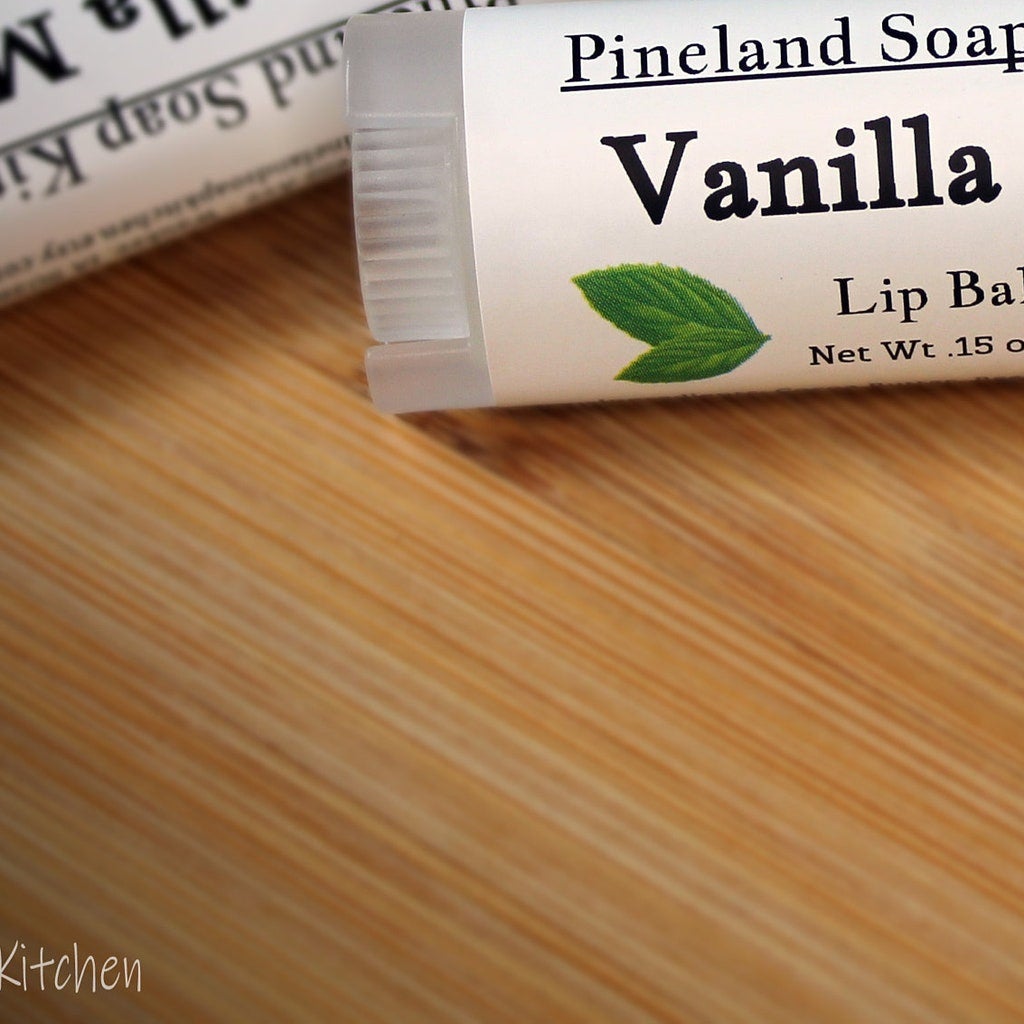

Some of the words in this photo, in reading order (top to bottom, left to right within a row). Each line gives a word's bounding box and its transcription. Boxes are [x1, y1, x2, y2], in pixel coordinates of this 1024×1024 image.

[563, 16, 868, 86] Pineland
[97, 72, 250, 151] Soap
[600, 113, 1003, 226] Vanilla
[833, 276, 929, 324] Lip
[808, 340, 873, 366] Net
[881, 338, 937, 362] Wt
[946, 334, 994, 358] .15
